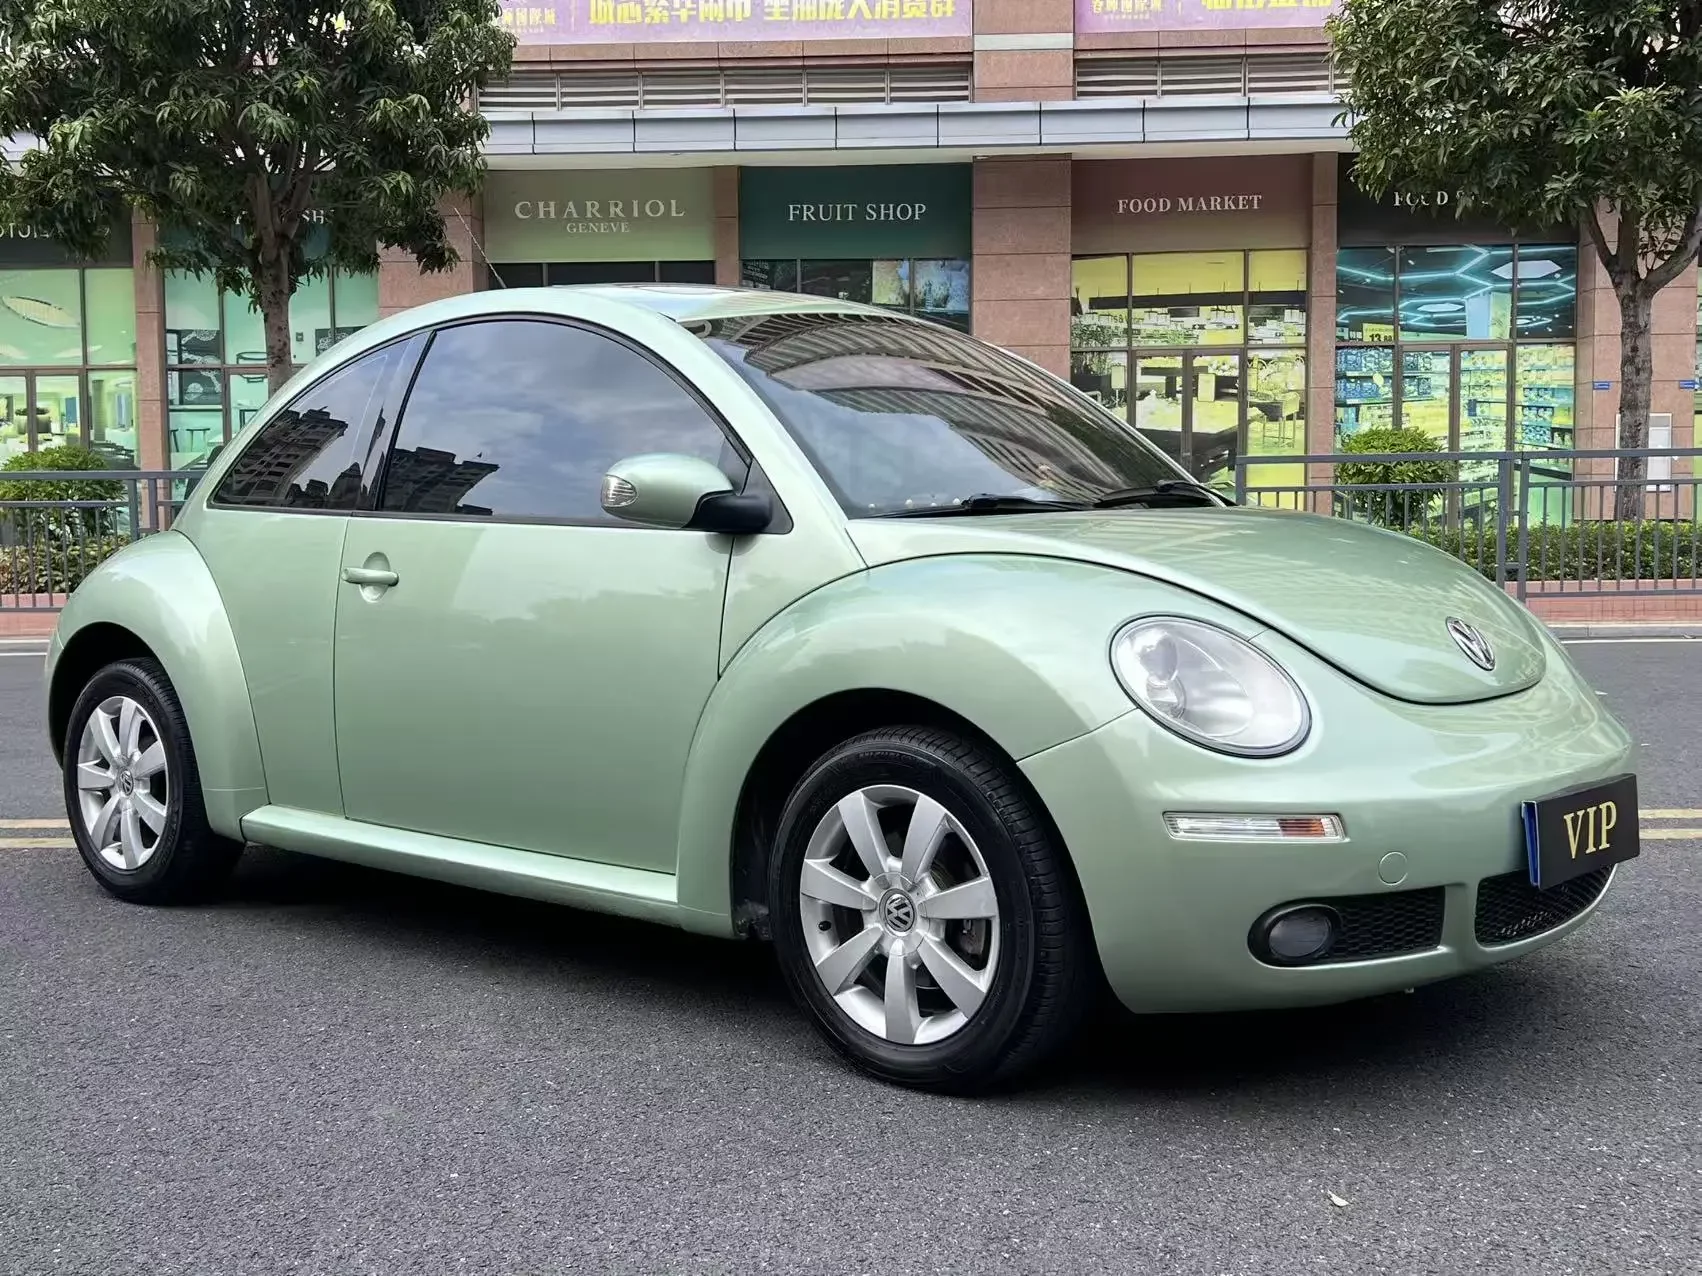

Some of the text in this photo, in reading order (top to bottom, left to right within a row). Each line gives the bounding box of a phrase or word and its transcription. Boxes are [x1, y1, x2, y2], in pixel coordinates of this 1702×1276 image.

[514, 200, 686, 220] CHARRIOL
[788, 203, 927, 221] FRUIT SHOP
[1117, 195, 1262, 214] FOOD MARKET
[566, 221, 630, 233] GENEVE
[1563, 801, 1617, 859] VIP
